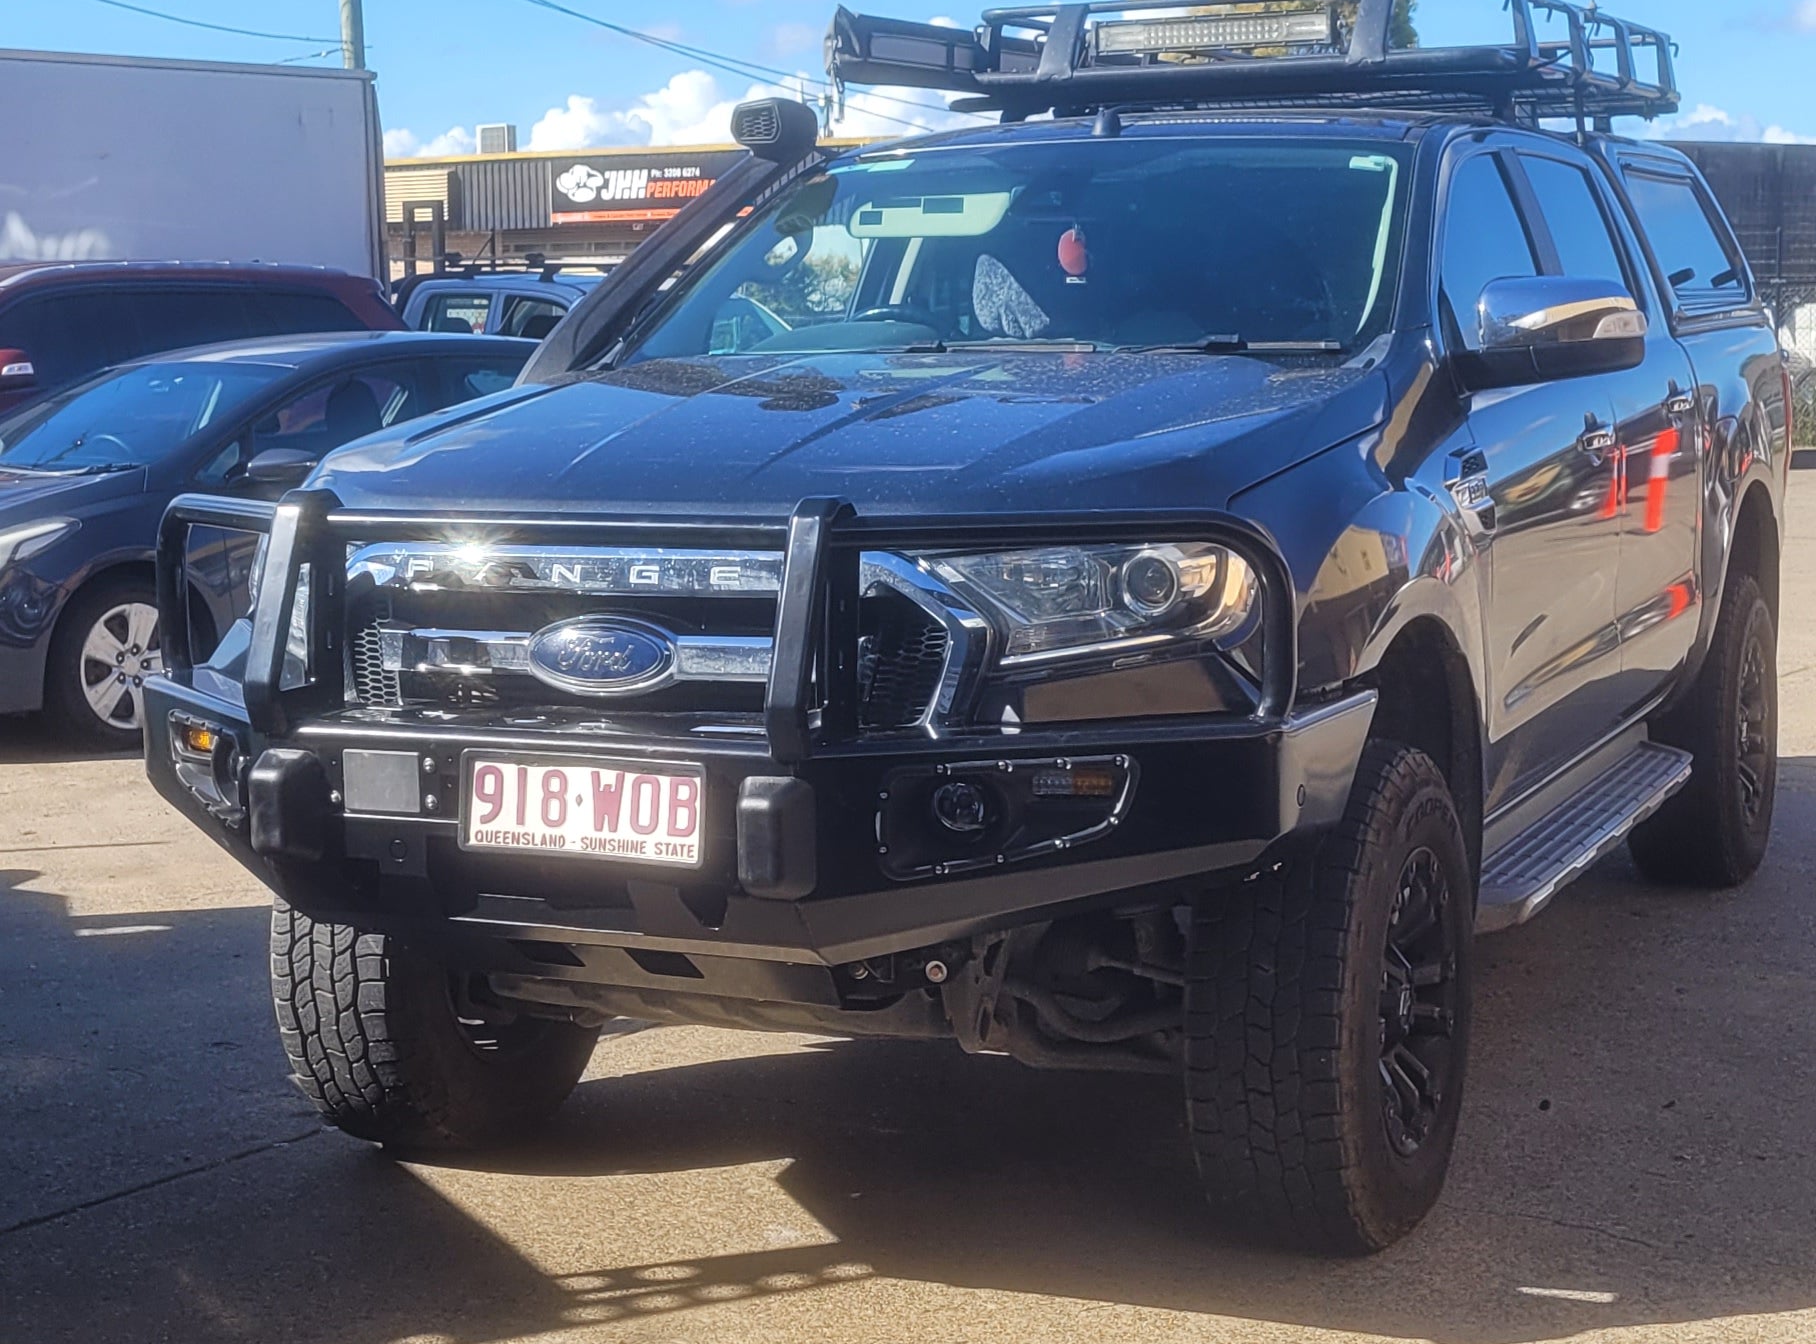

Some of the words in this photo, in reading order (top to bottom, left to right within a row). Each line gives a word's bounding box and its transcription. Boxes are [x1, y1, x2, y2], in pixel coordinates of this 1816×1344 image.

[600, 169, 649, 201] JHH
[406, 556, 742, 586] RANGE
[558, 636, 634, 672] Ford
[474, 829, 566, 849] QUEENSLAND
[580, 835, 648, 855] SUNSHINE
[654, 841, 695, 858] STATE
